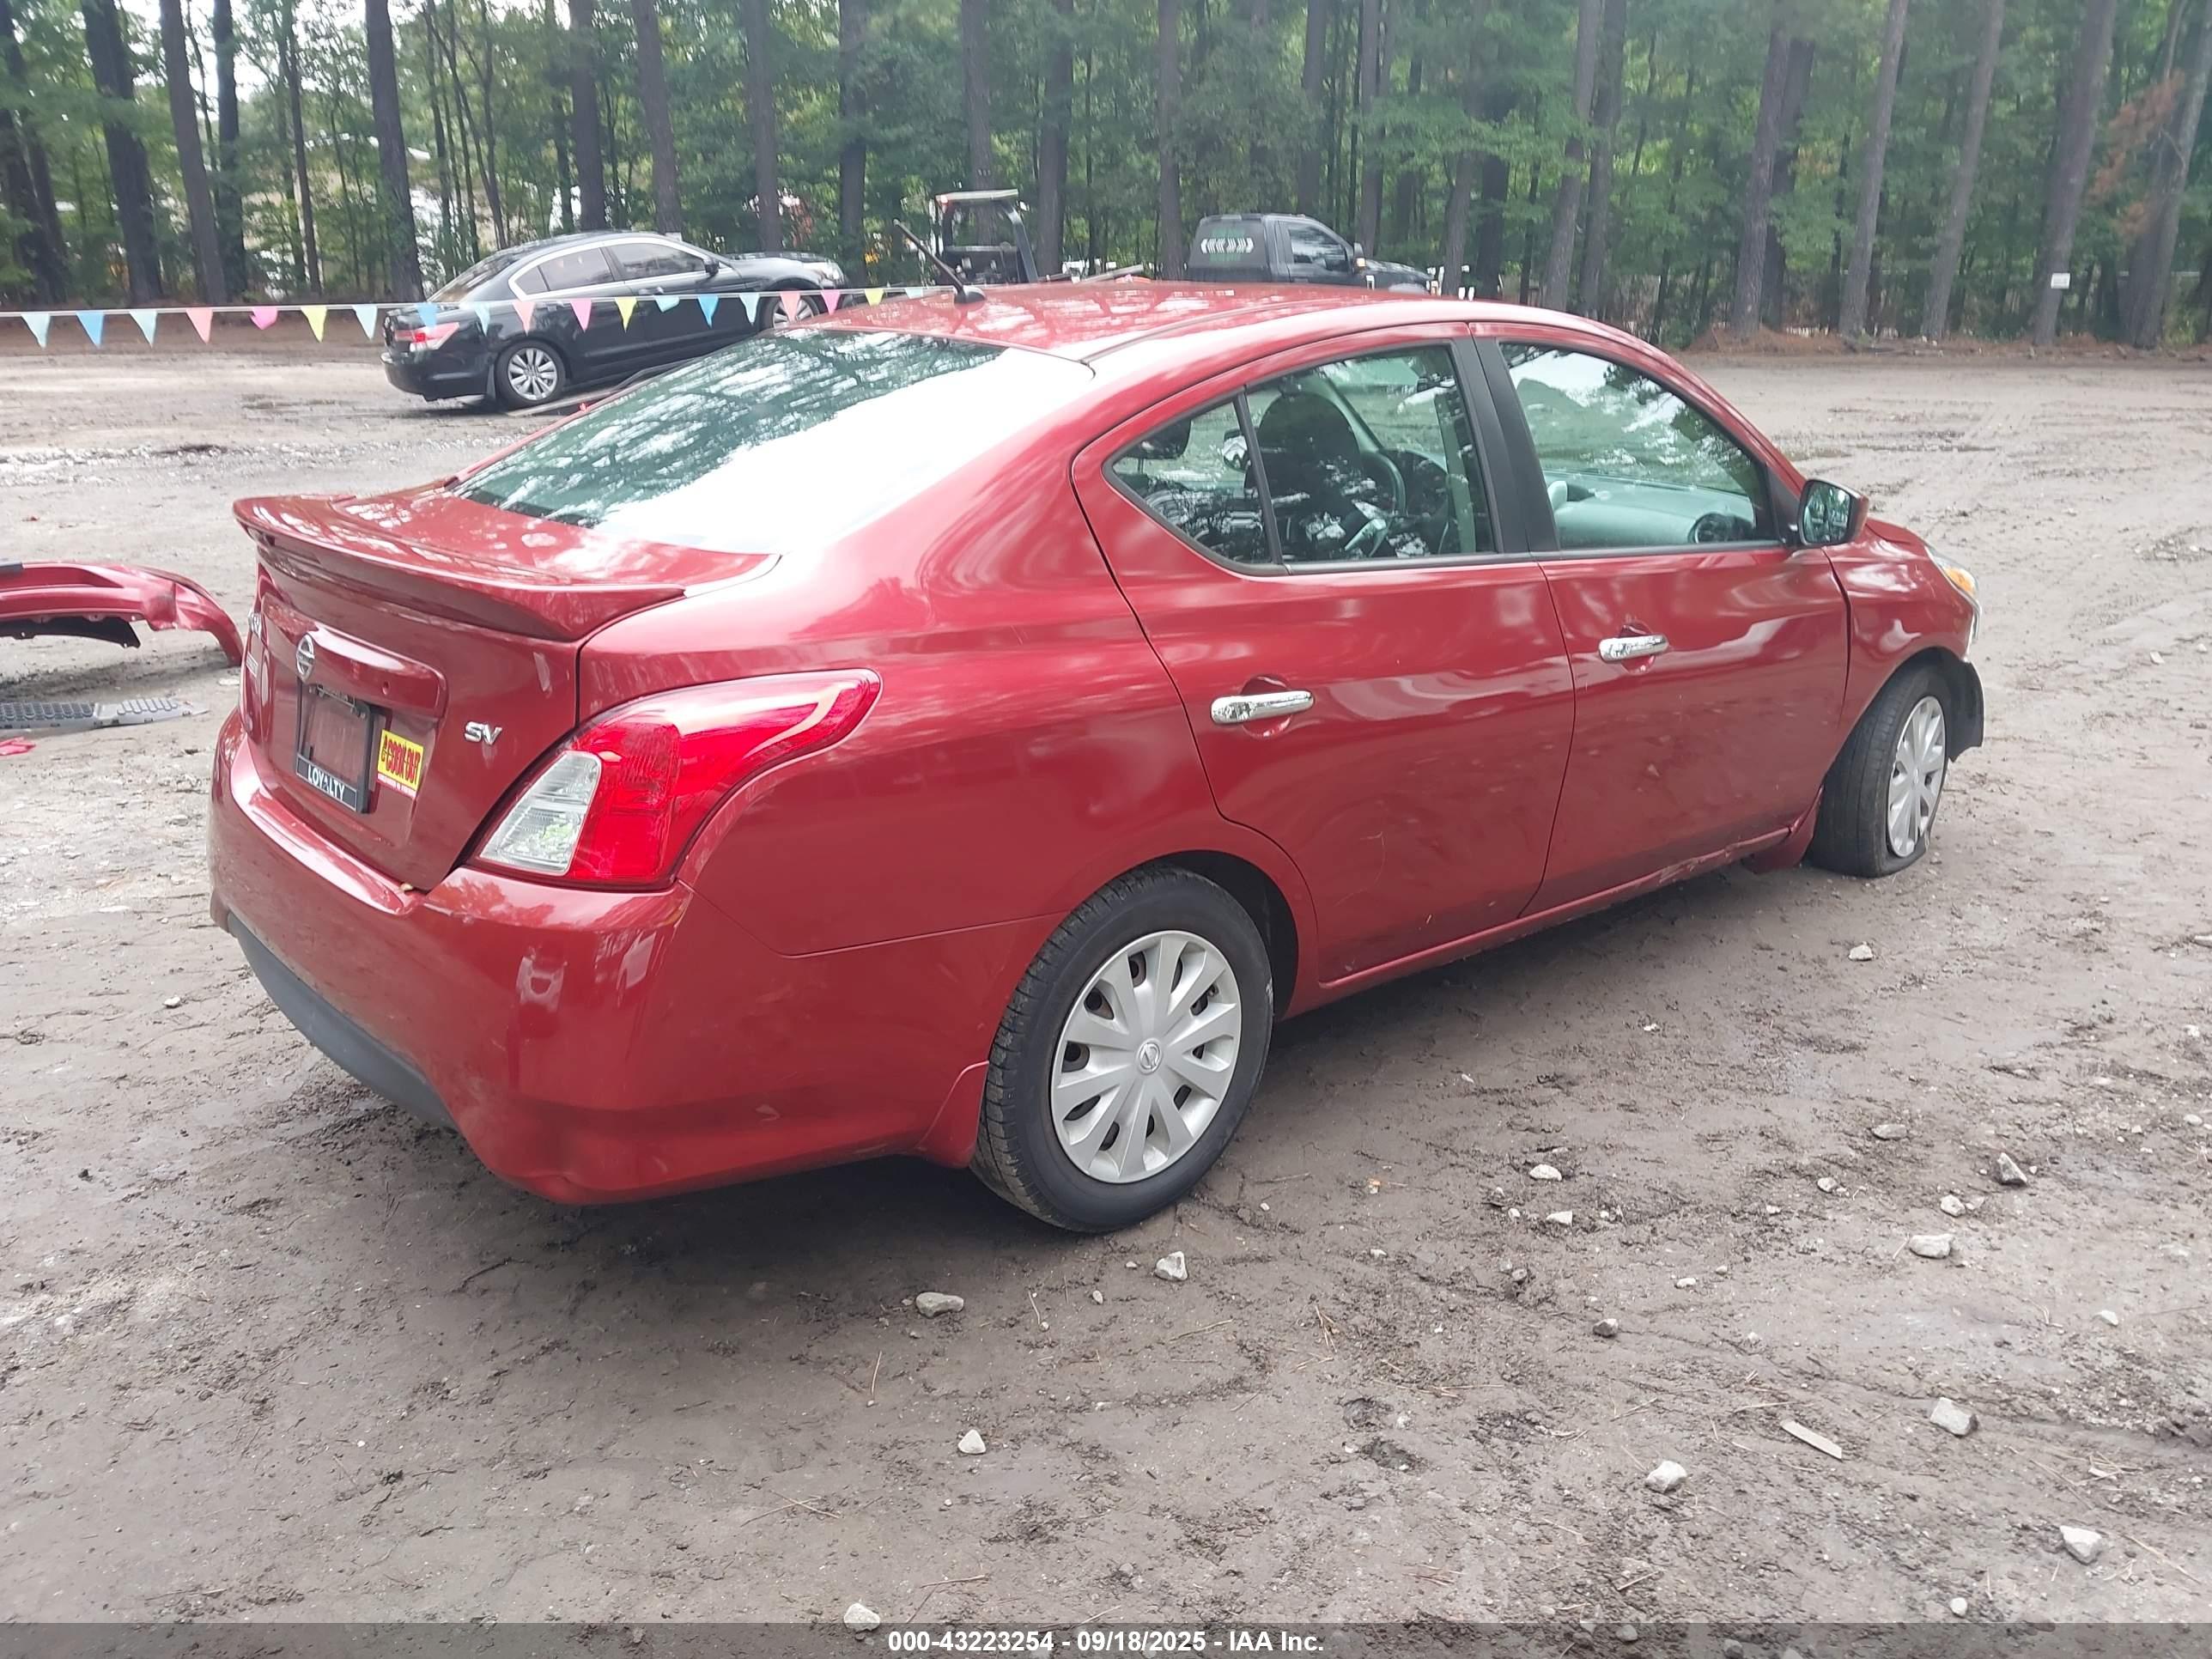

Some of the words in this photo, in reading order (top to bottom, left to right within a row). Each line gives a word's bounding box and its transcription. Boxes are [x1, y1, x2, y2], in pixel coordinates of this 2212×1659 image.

[465, 721, 502, 745] SV
[308, 764, 345, 802] LOYALTY
[404, 747, 422, 786] OUT
